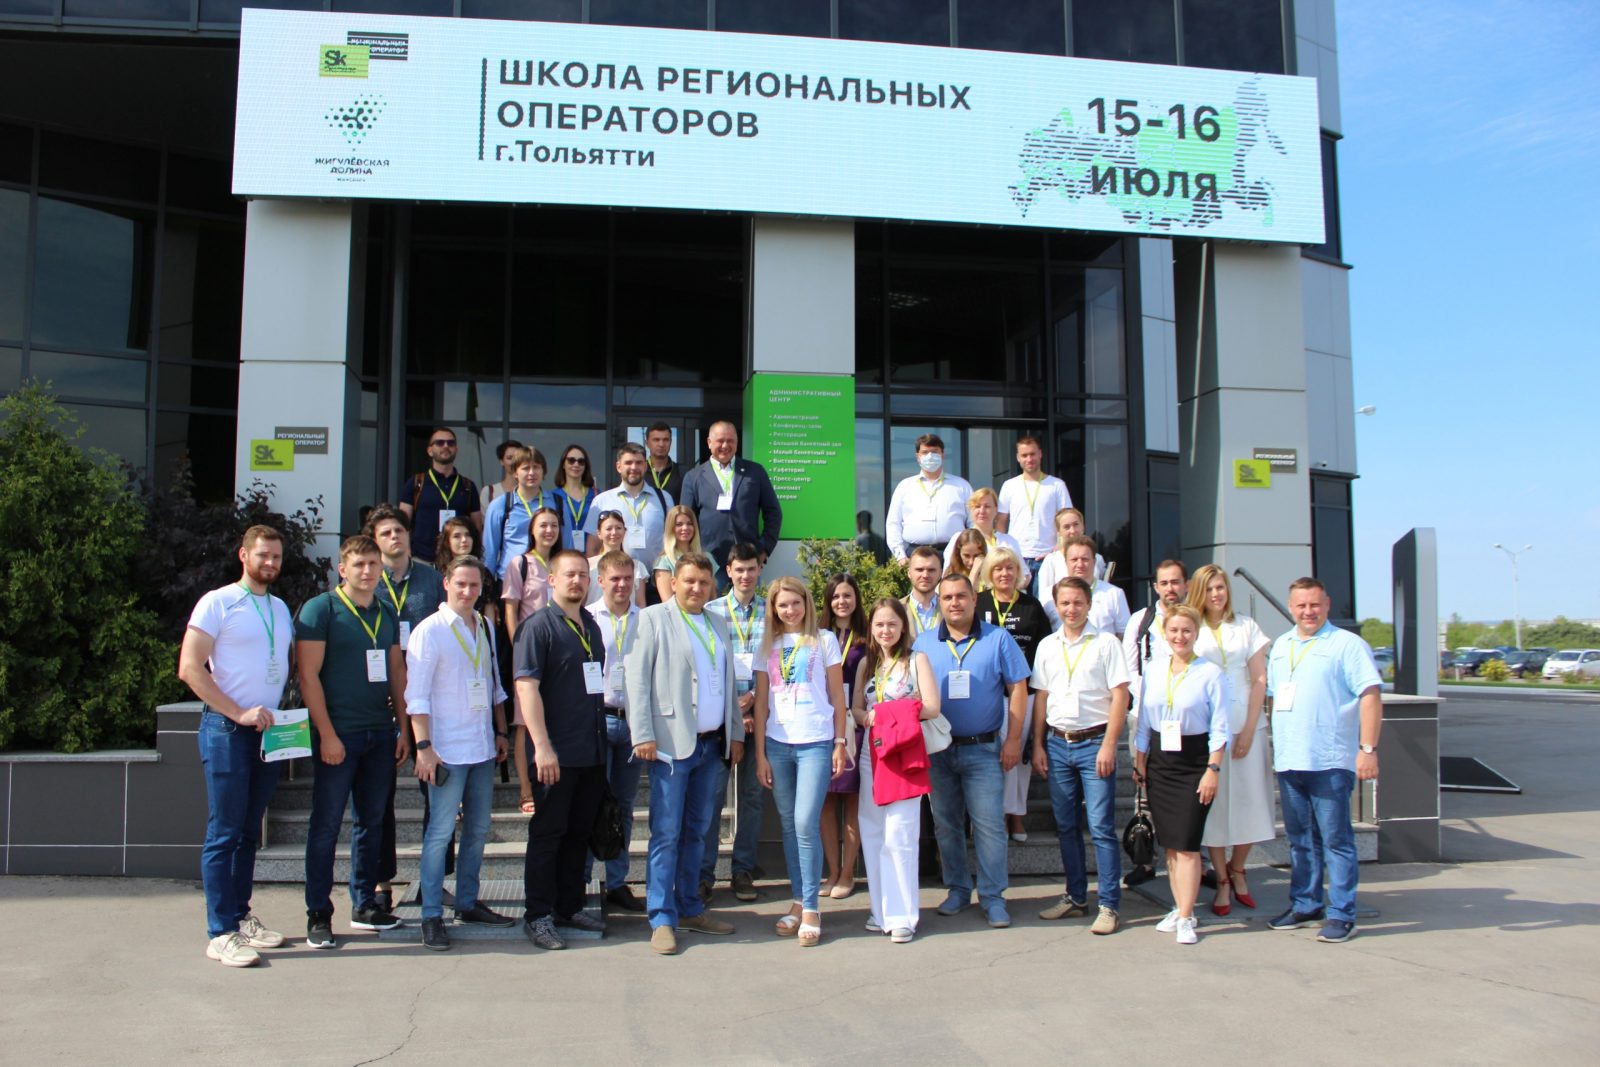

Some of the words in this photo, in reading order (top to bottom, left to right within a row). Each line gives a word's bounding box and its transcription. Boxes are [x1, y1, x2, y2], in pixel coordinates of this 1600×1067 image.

[324, 49, 347, 66] Sk
[499, 59, 644, 91] ШКОЛА
[657, 66, 971, 110] РЕГИОНАЛЬНЫХ
[497, 100, 759, 138] ОПЕРАТОРОВ
[1088, 97, 1221, 142] 15-16
[330, 166, 372, 175] ДОЛИНА
[495, 140, 655, 168] г.Тольятти
[1091, 165, 1220, 203] ИЮЛЯ
[255, 444, 275, 460] Sk
